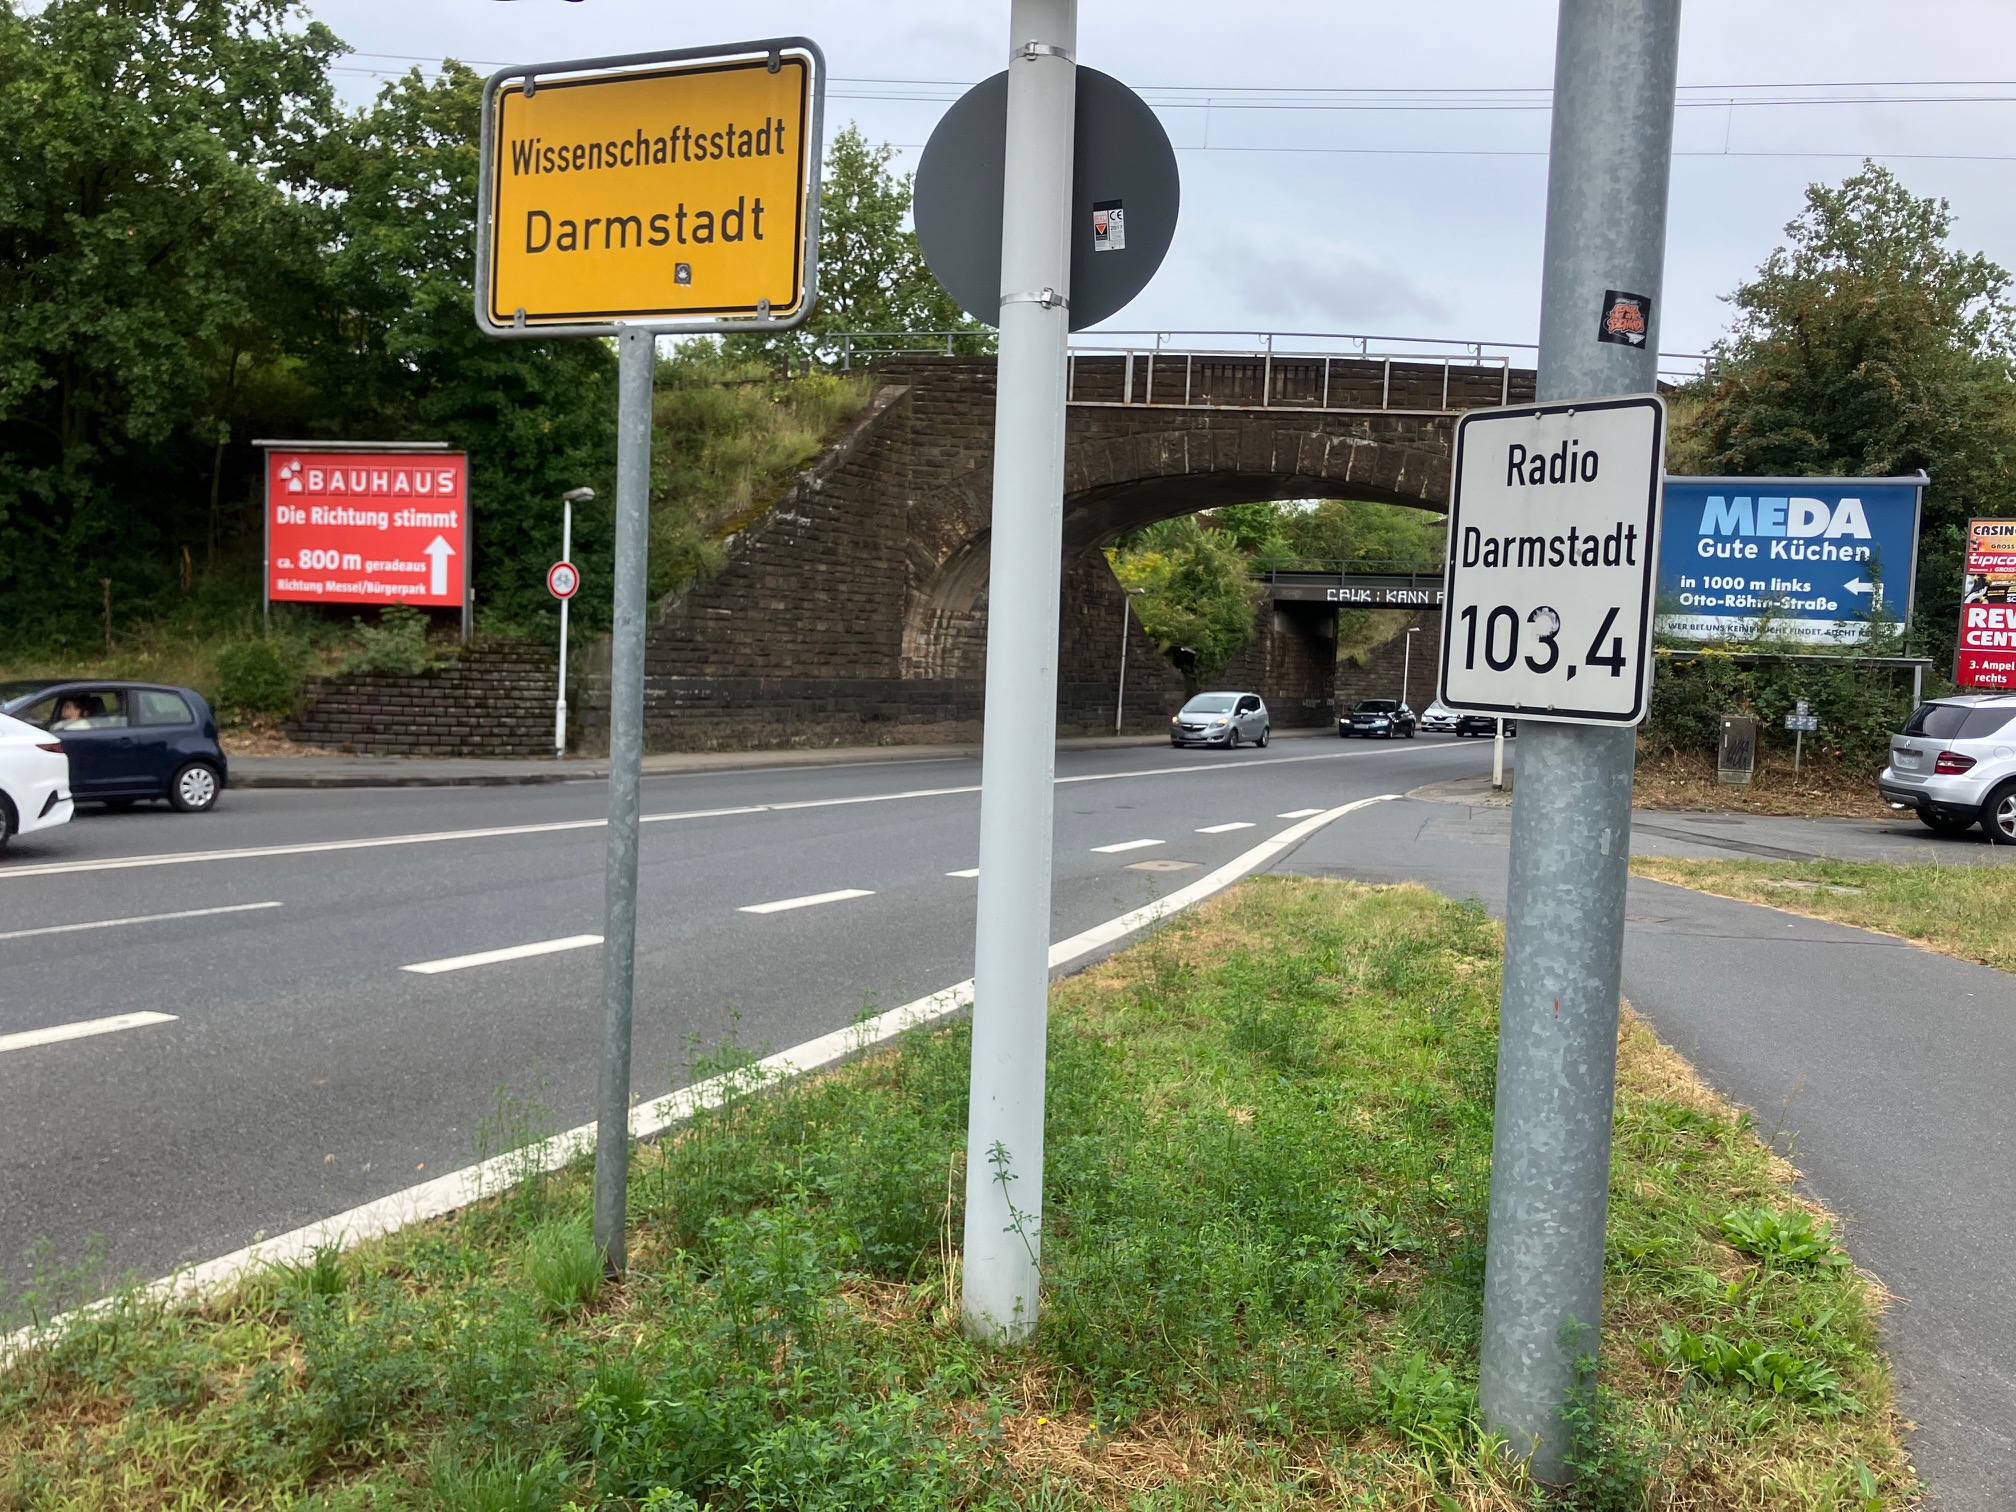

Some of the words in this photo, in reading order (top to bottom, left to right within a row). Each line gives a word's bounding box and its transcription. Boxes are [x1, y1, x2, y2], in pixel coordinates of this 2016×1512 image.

[511, 116, 786, 176] Wissenschaftsstadt
[525, 196, 764, 254] Darmstadt
[1506, 439, 1599, 487] Radio
[308, 469, 454, 493] BAUHAUS
[276, 504, 306, 525] Die
[310, 506, 389, 530] Richtung
[393, 508, 458, 528] stimmt
[1698, 495, 1872, 539] MEDA
[1973, 525, 2016, 536] CASIN
[1461, 522, 1638, 568] Darmstadt
[1697, 537, 1758, 559] Gute
[1770, 539, 1871, 562] Küchen
[277, 557, 294, 569] ca.
[299, 549, 339, 570] 800
[342, 553, 362, 570] m
[365, 558, 427, 573] geradeaus
[277, 578, 323, 593] Richtung
[325, 579, 426, 596] Messel/Bürgerpark
[1680, 575, 1696, 588] in
[1703, 576, 1745, 590] 1000
[1749, 578, 1766, 591] m
[1771, 578, 1811, 592] links
[1386, 589, 1429, 604] KANN
[1679, 592, 1838, 611] Otto-Röhm-Straße
[1668, 622, 1688, 630] WER
[1461, 604, 1626, 682] 103,4
[1969, 660, 1980, 669] 3.
[1982, 660, 2015, 672] Ampel
[1975, 673, 2007, 683] rechts
